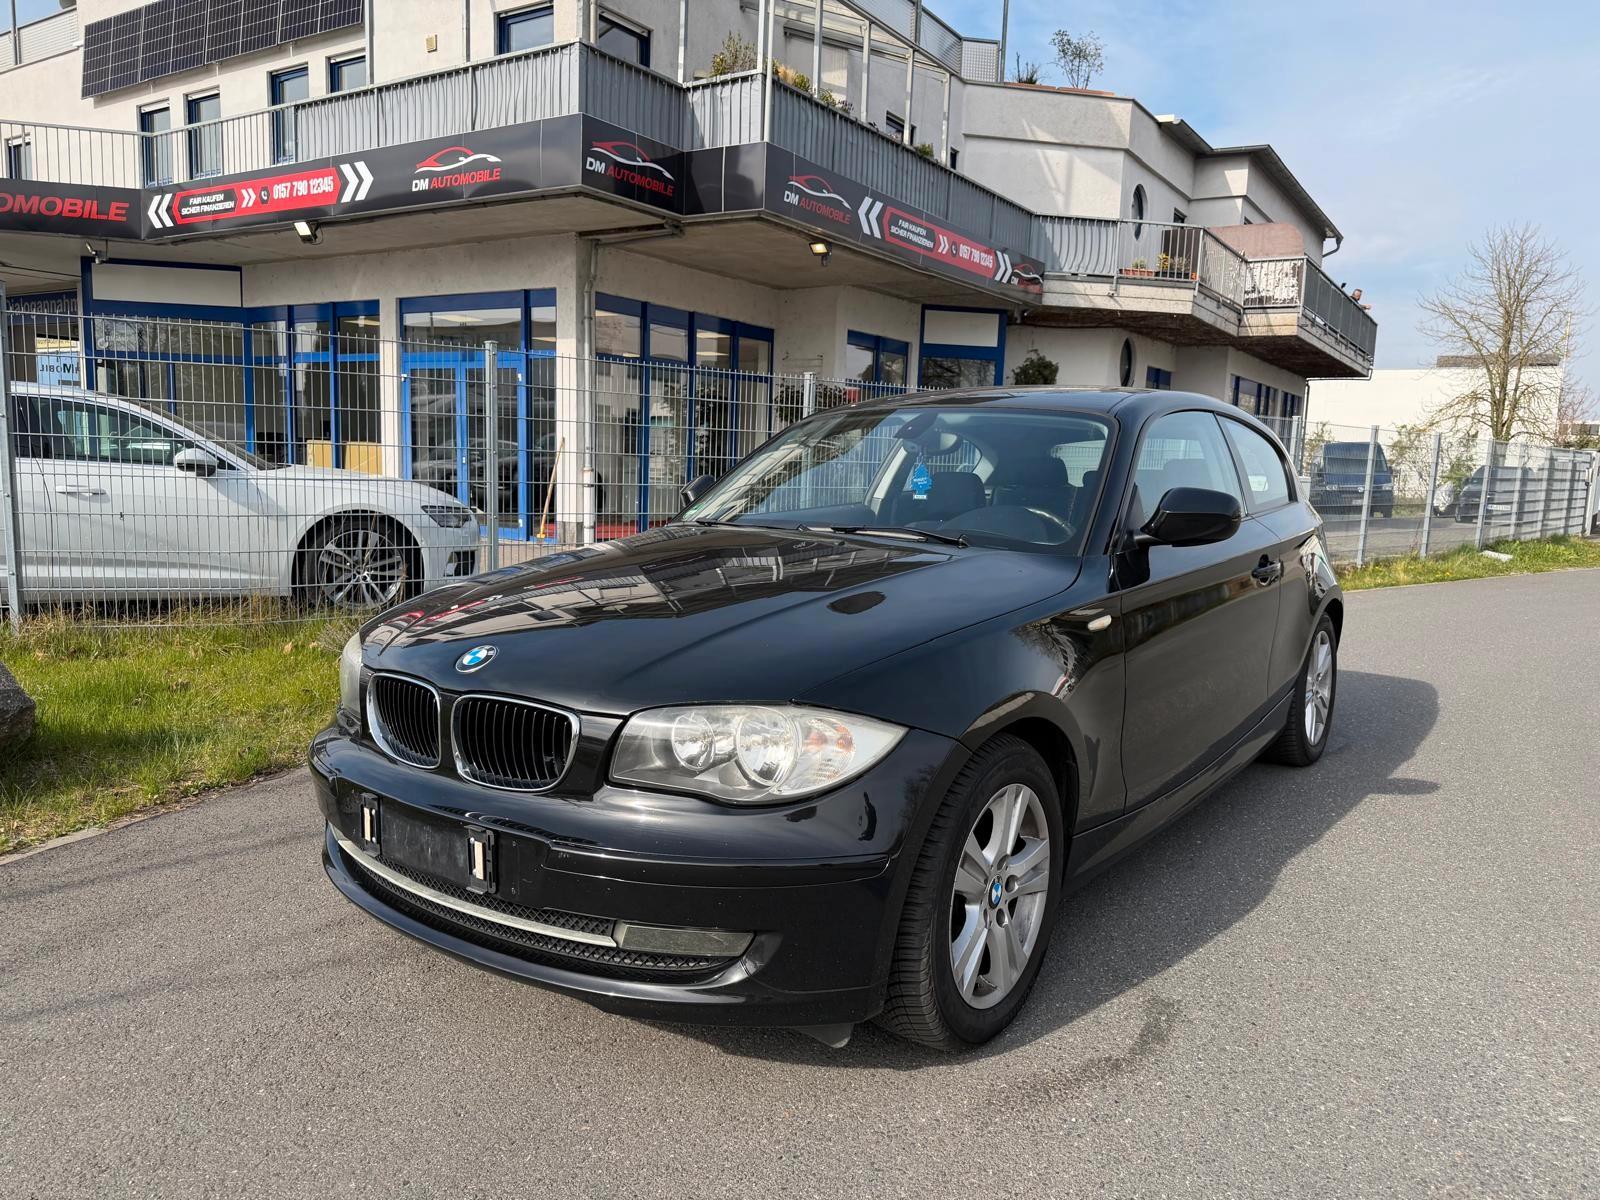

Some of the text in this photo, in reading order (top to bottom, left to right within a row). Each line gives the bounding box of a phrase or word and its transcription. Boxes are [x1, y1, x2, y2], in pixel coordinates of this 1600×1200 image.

[273, 176, 334, 200] 0157 790 12345
[412, 168, 502, 192] DM AUTOMOBILE
[586, 157, 675, 196] DM AUTOMOBILE
[181, 205, 201, 216] SICHER
[189, 193, 225, 206] FAIR KAUFEN
[783, 190, 852, 225] DM AUTOMOBILE
